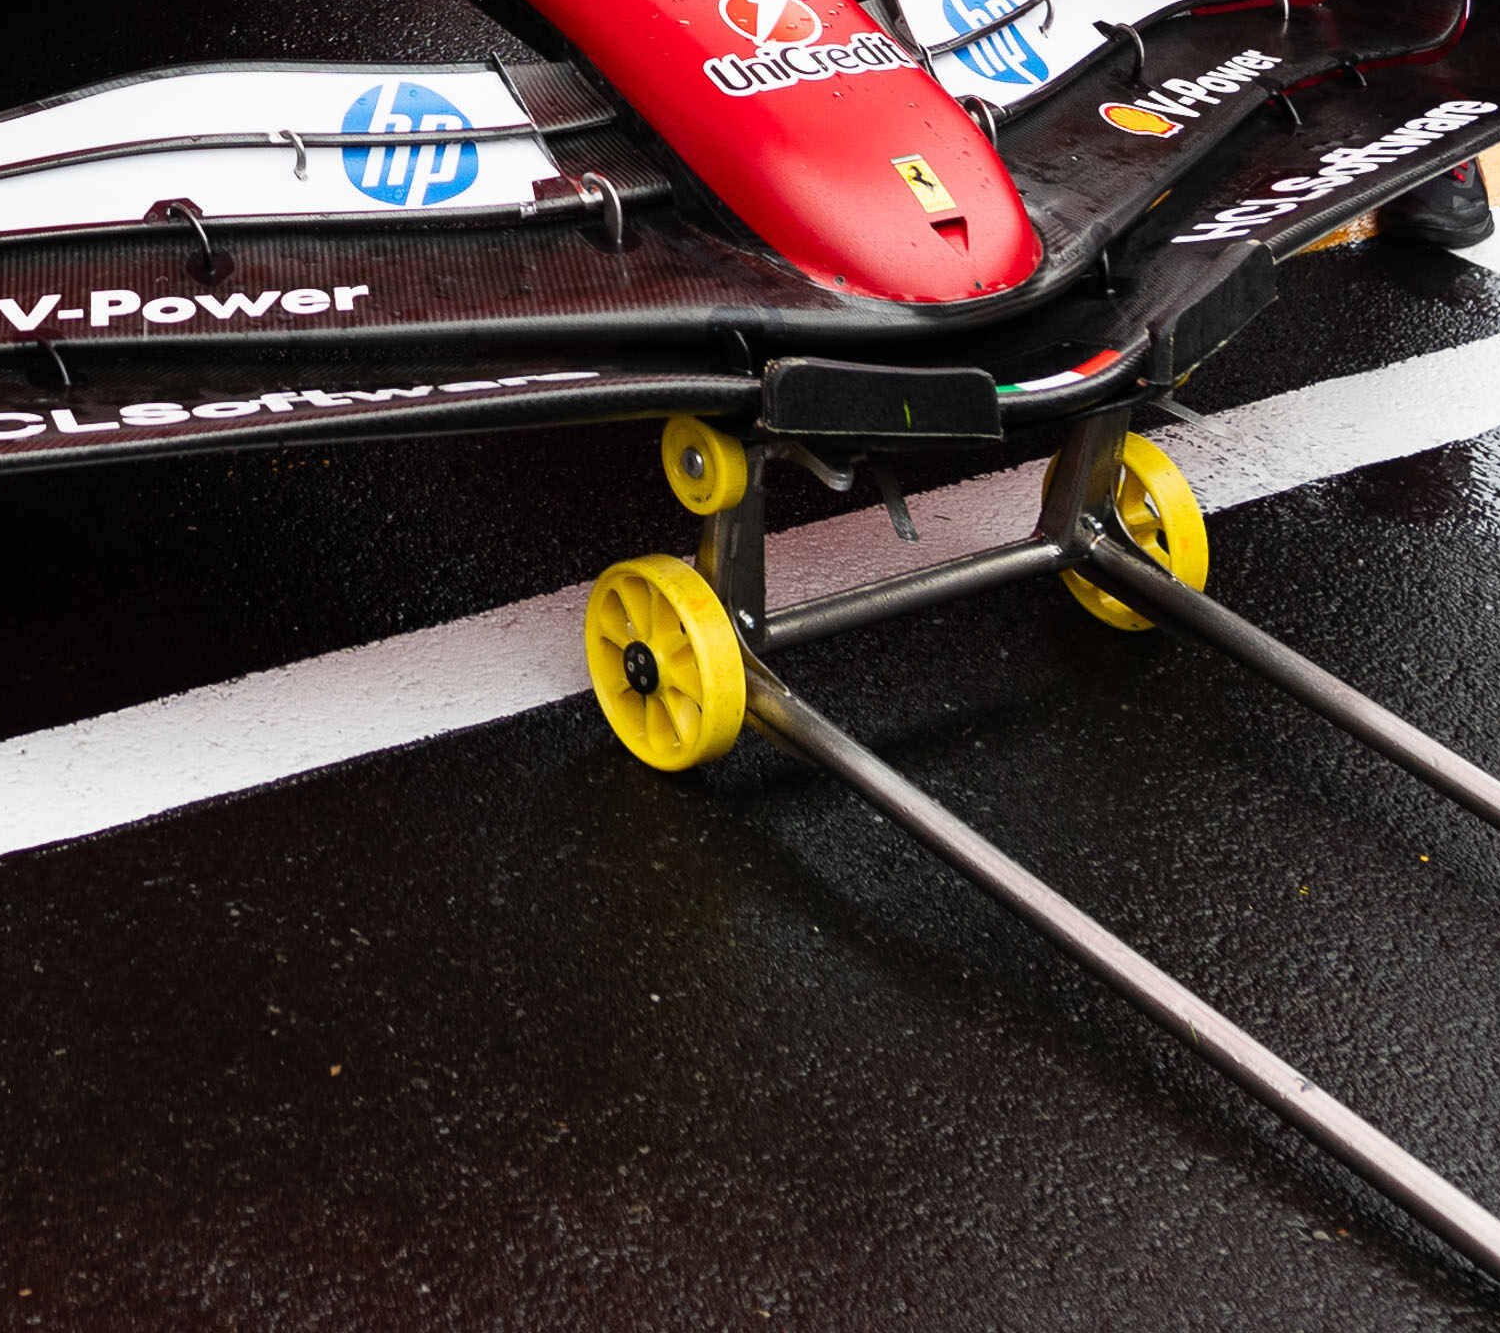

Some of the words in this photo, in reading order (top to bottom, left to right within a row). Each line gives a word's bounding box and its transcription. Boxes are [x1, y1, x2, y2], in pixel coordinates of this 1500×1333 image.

[710, 35, 914, 95] UniCredit
[1148, 49, 1283, 118] V-Power
[348, 82, 470, 206] hp
[1171, 101, 1498, 243] HCLSoftware
